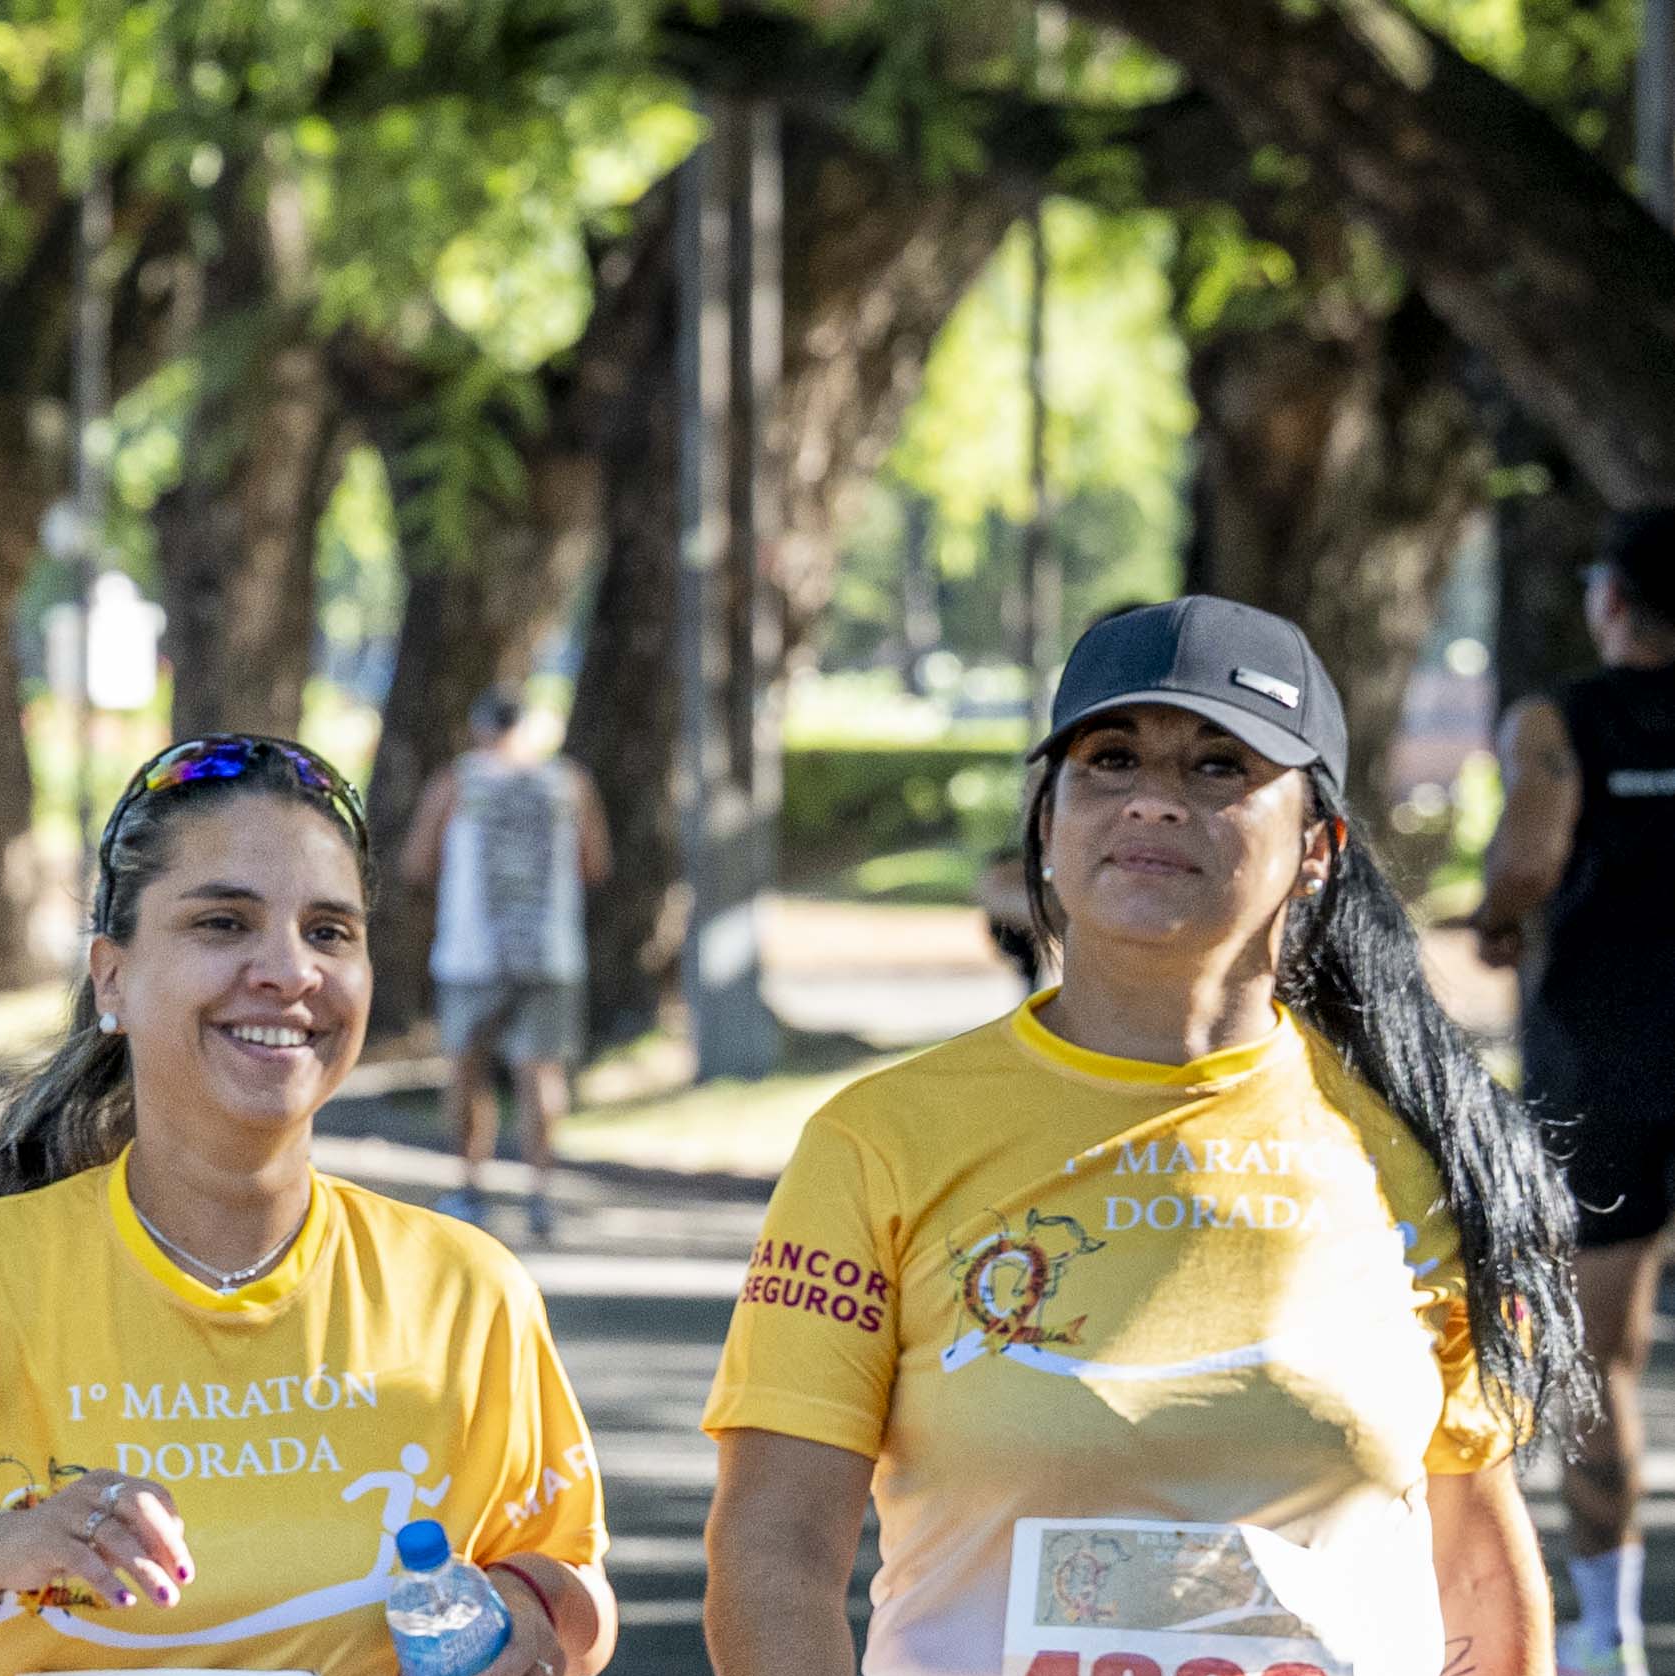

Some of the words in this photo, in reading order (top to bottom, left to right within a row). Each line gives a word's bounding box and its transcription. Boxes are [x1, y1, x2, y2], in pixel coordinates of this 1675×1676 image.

[1113, 1138, 1377, 1177] MARAT
[1103, 1195, 1333, 1232] DORADA
[122, 1364, 380, 1420] MARATÓN
[114, 1434, 344, 1482] DORADA
